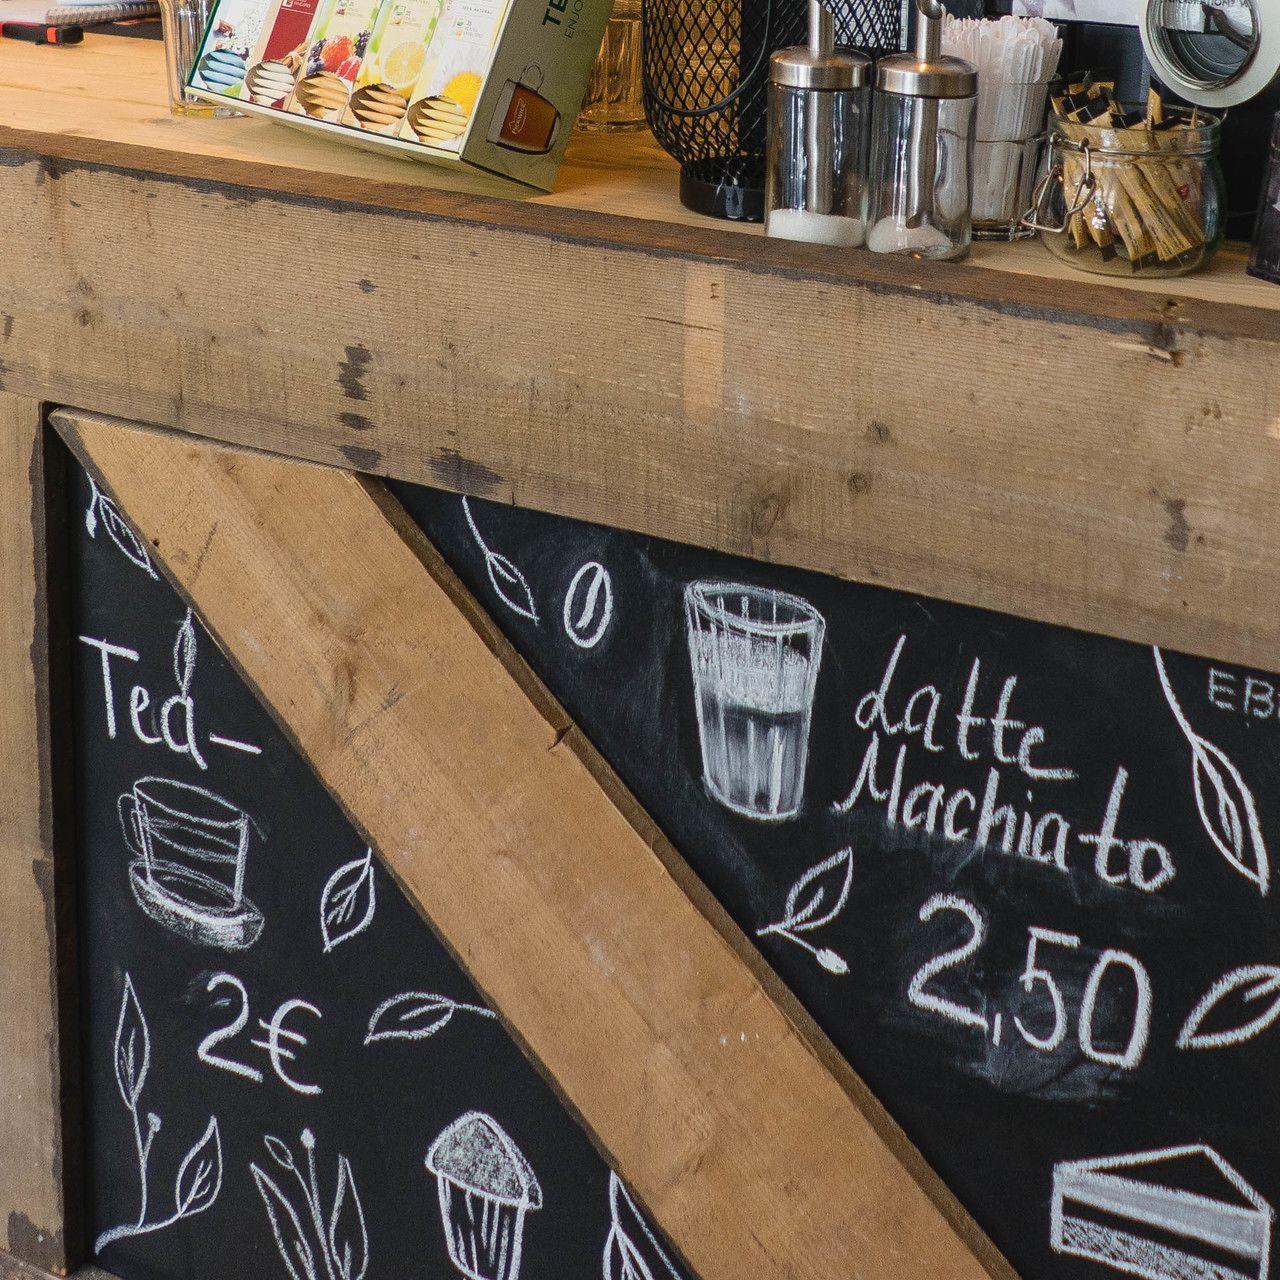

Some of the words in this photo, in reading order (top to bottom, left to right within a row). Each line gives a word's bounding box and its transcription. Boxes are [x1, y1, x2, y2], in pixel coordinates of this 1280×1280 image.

[854, 632, 1076, 781] Latte
[832, 731, 1177, 893] Machiato
[196, 971, 323, 1095] 2€
[906, 891, 1152, 1071] 2,50
